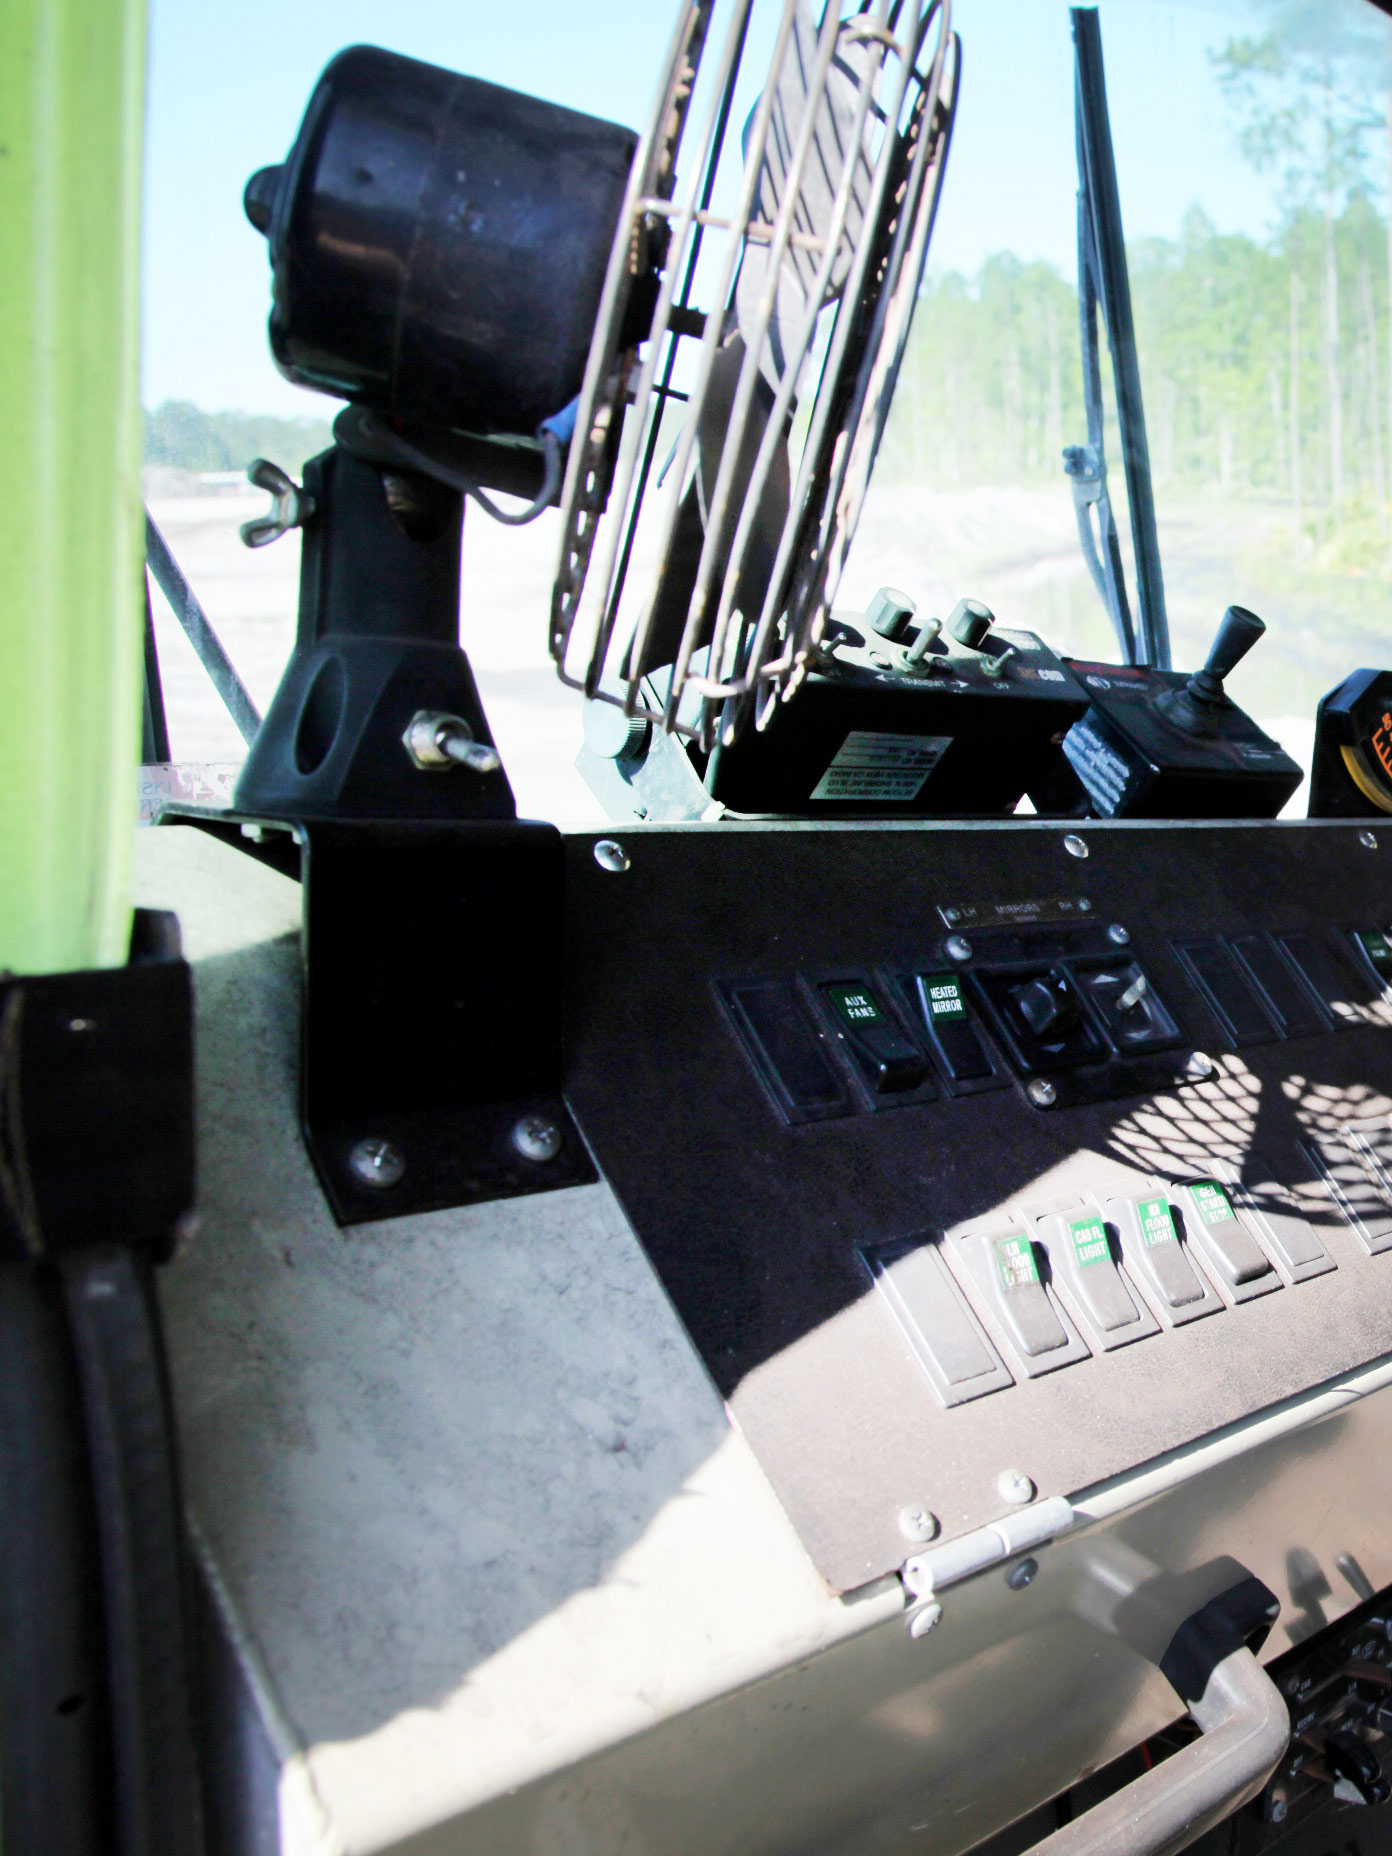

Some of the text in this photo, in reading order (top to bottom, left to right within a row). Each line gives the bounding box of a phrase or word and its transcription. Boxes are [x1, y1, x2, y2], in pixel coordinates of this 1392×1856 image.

[900, 677, 946, 689] TRANSMIT
[993, 681, 1010, 690] OFF
[962, 907, 978, 917] LH
[994, 903, 1041, 915] MIRRORS
[1058, 900, 1073, 911] RH
[930, 985, 958, 999] HEATED
[844, 995, 868, 1007] AUX
[931, 998, 963, 1014] MIRROR
[847, 1006, 876, 1019] FANS
[1199, 1184, 1217, 1199] GEN
[1148, 1202, 1162, 1216] RH
[1145, 1214, 1170, 1233] FLOOD
[1075, 1229, 1092, 1244] CAB
[1148, 1226, 1173, 1245] LIGHT
[1005, 1241, 1020, 1258] LH
[1078, 1242, 1107, 1260] LIGHT
